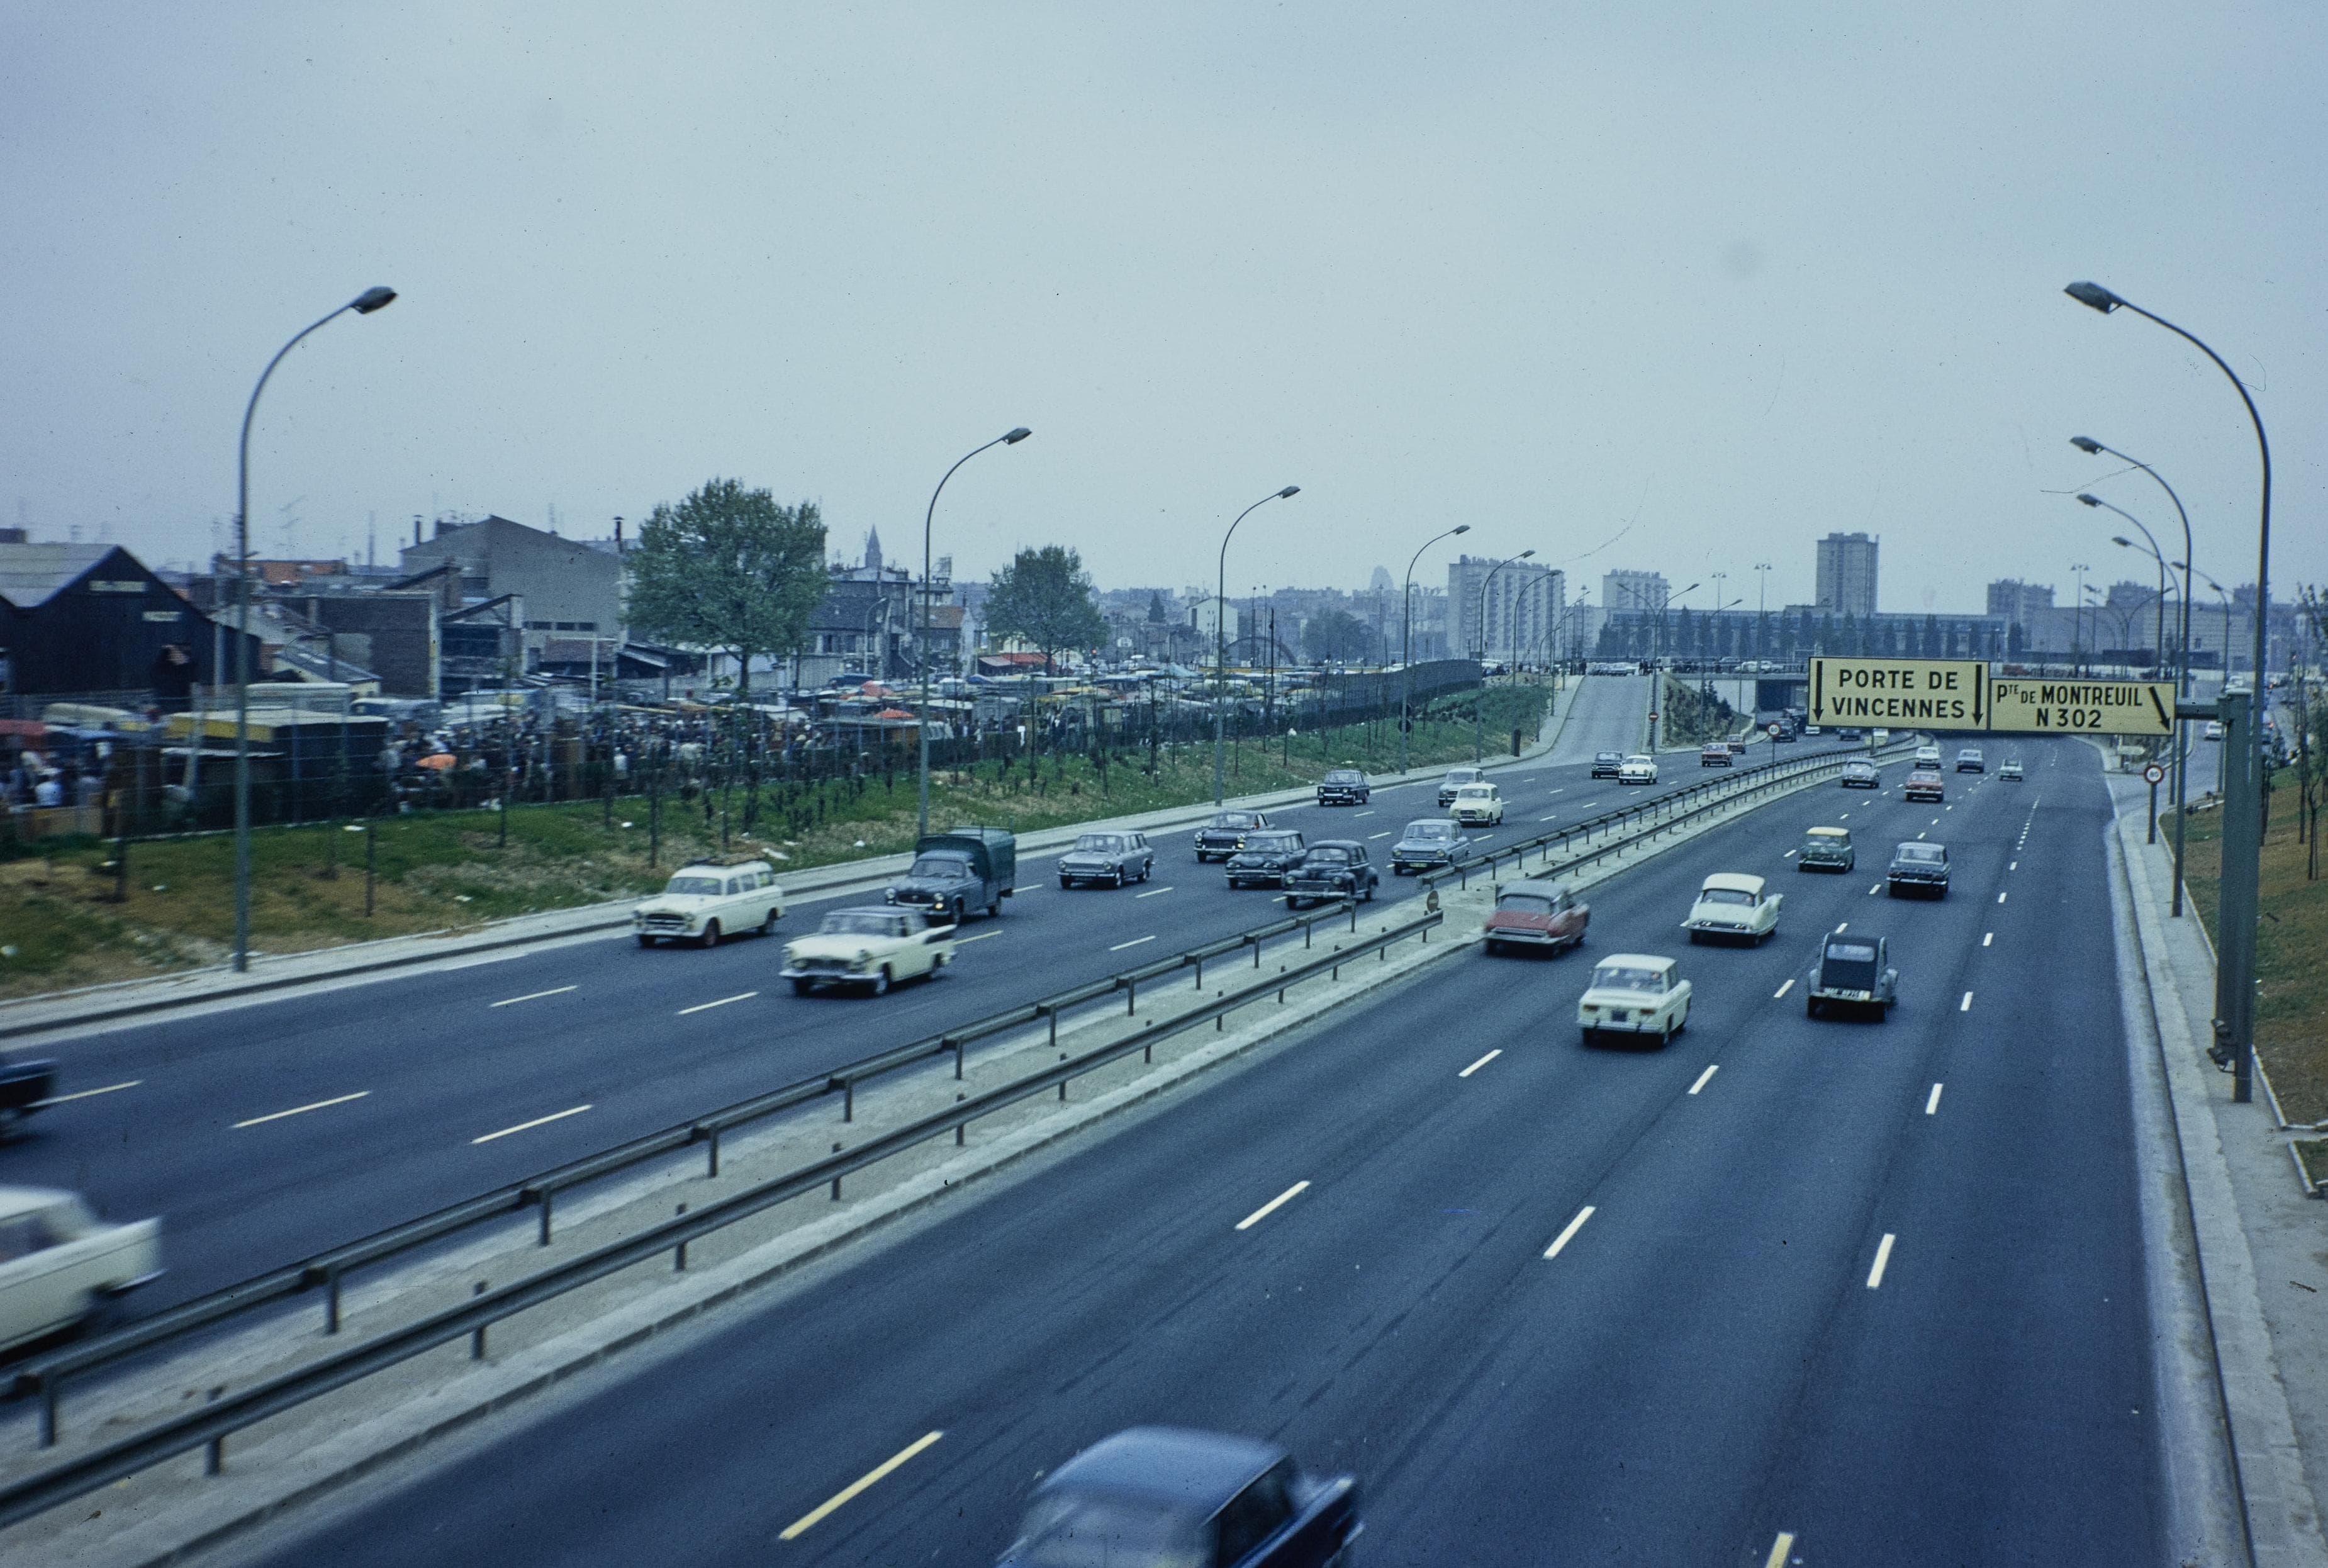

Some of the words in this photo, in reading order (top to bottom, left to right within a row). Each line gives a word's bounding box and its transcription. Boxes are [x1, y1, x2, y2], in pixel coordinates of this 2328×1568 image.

[1838, 669, 1915, 689] PORTE
[1928, 671, 1958, 690] DE
[2020, 690, 2036, 704] DE
[2040, 685, 2143, 707] MONTREUIL
[1832, 697, 1966, 719] VINCENNES
[2036, 708, 2049, 727] N
[2056, 708, 2102, 729] 302
